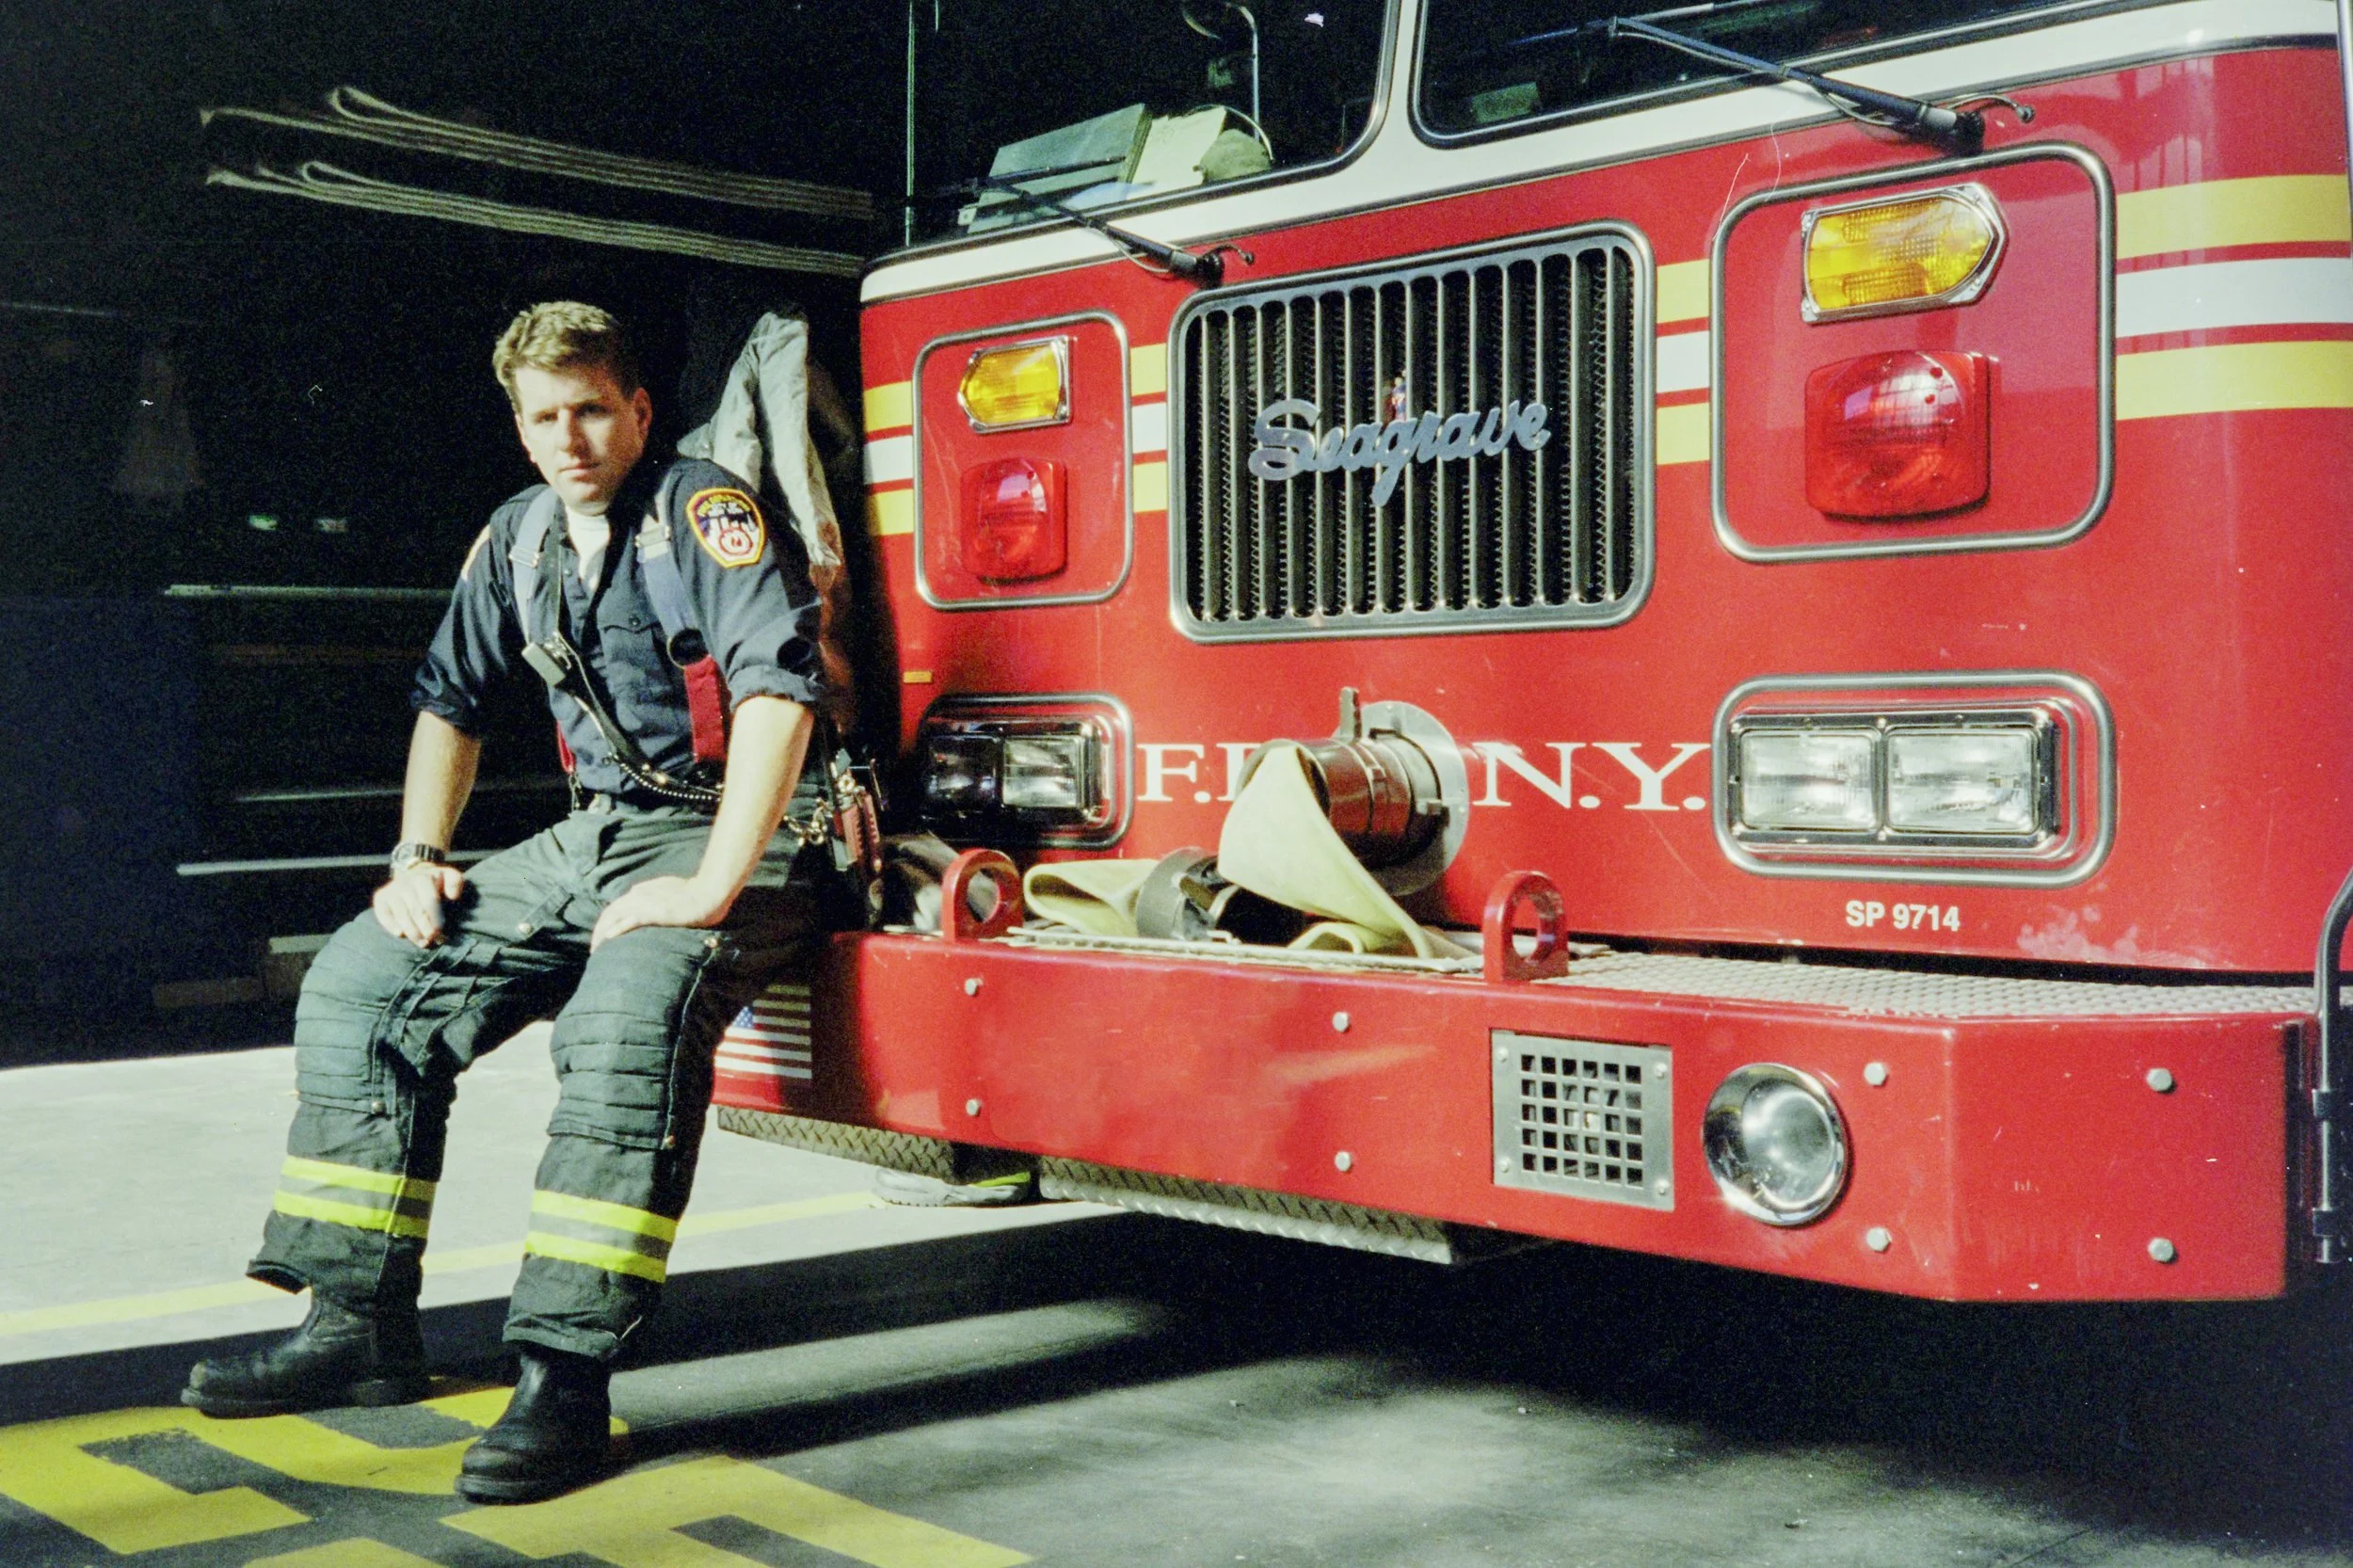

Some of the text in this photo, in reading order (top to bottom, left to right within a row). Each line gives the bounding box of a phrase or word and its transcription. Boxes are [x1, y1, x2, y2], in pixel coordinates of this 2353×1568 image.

[1248, 398, 1552, 507] Seagrave
[1845, 900, 1961, 932] SP 9714
